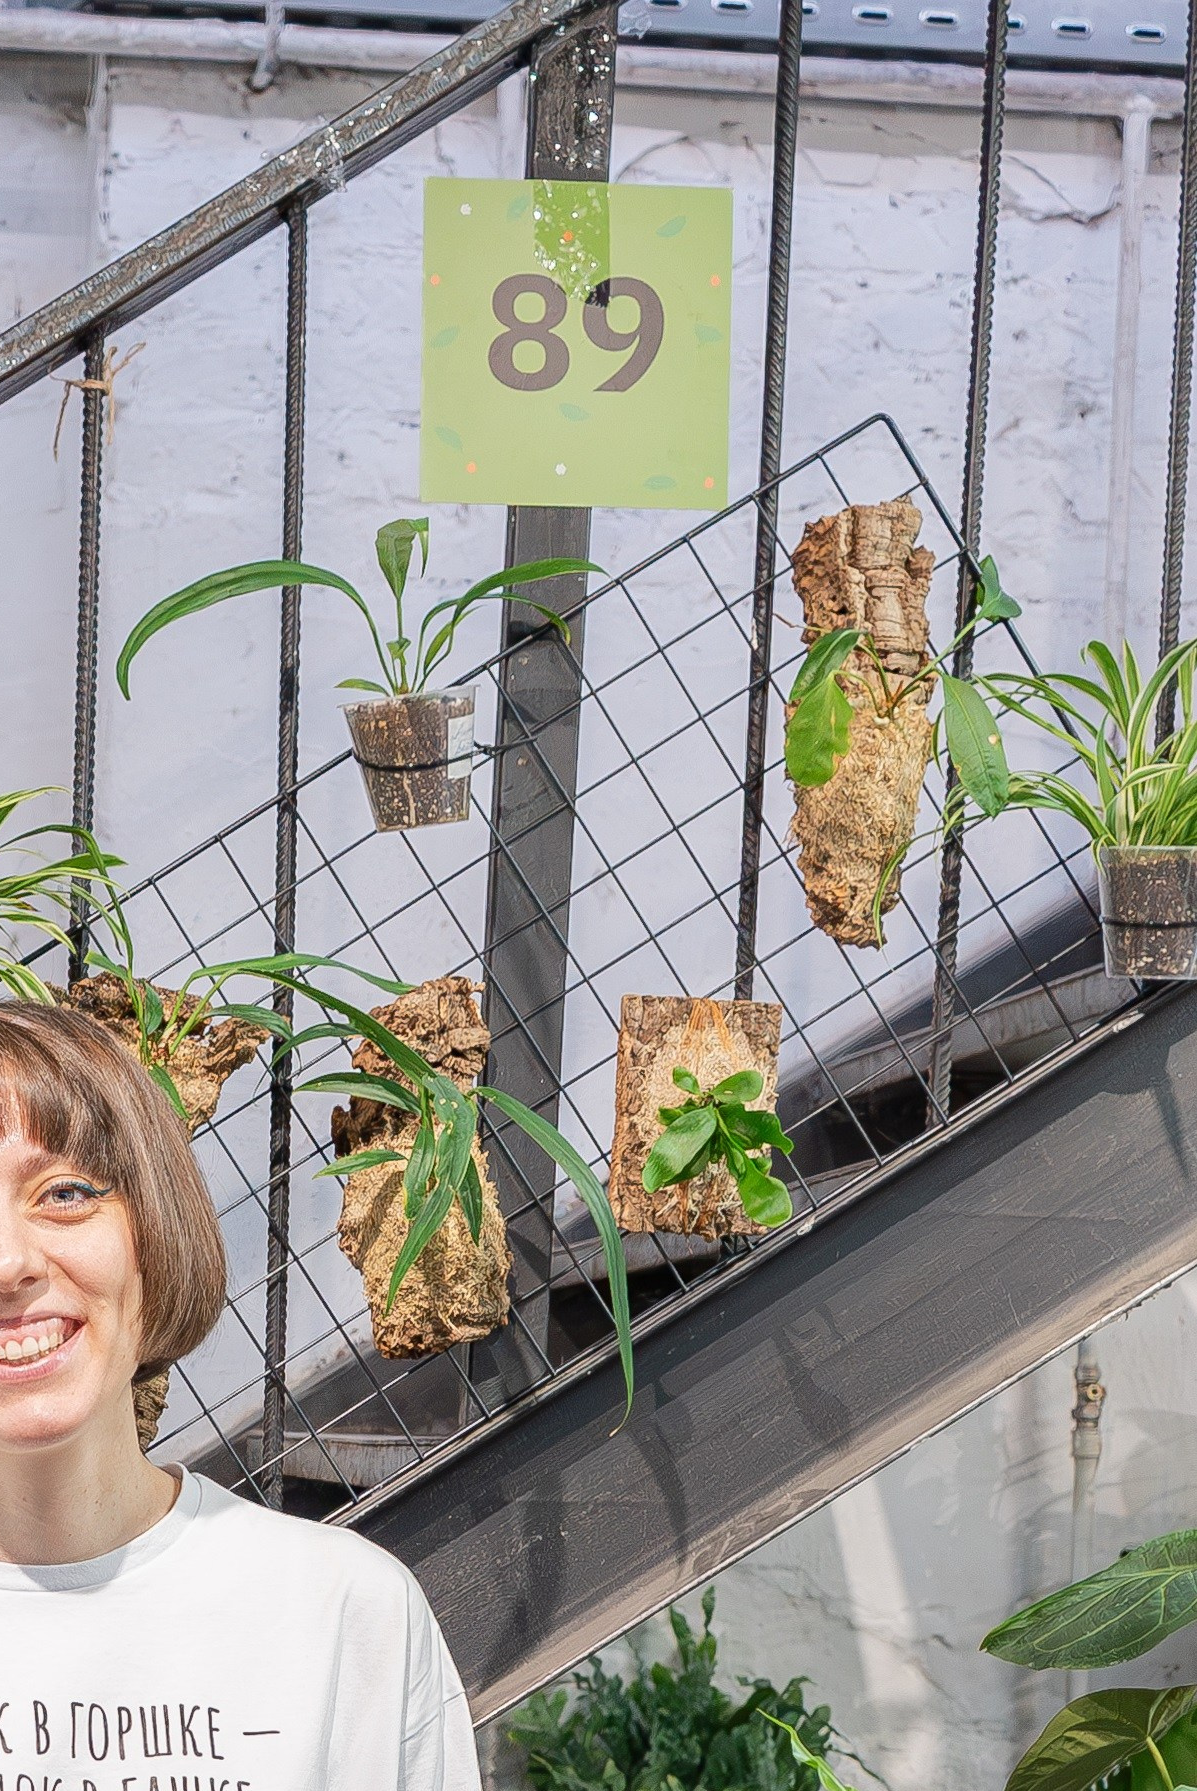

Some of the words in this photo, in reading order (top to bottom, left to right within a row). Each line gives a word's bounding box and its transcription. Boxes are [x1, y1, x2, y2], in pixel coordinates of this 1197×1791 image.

[488, 273, 664, 393] 89
[33, 1700, 50, 1755] В
[71, 1702, 225, 1761] ГОРШКЕ
